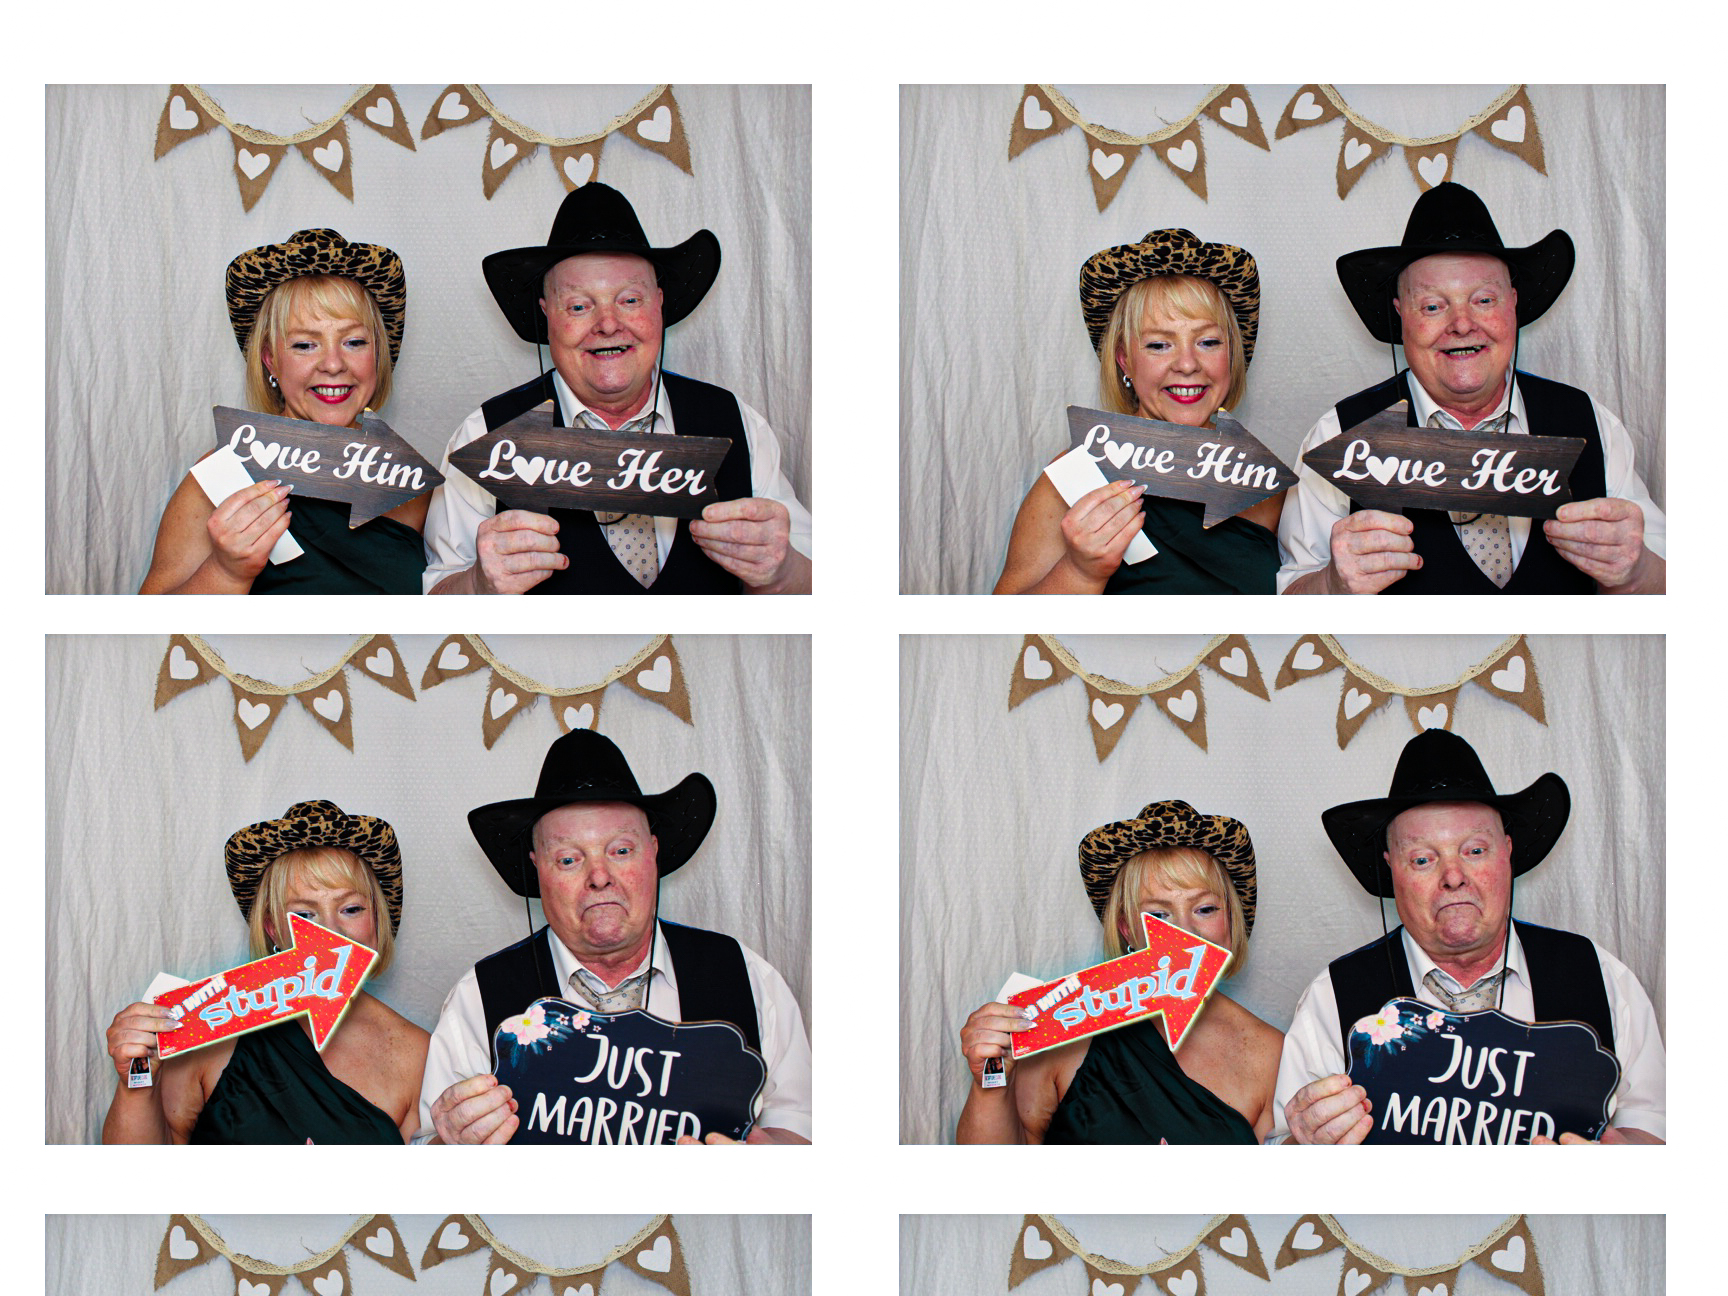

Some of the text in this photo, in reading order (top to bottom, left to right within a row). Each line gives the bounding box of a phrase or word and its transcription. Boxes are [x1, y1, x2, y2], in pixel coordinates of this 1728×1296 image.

[333, 442, 425, 490] Him
[606, 448, 707, 496] Her
[1187, 442, 1279, 490] Him
[1460, 448, 1561, 496] Her
[182, 974, 228, 1012] WITH
[199, 944, 353, 1030] stupid
[1036, 974, 1082, 1012] WITH
[1053, 944, 1207, 1030] stupid
[573, 1033, 681, 1097] JUST
[1427, 1033, 1535, 1097] JUST
[527, 1092, 702, 1144] MARRIED
[1381, 1092, 1556, 1144] MARRIED
